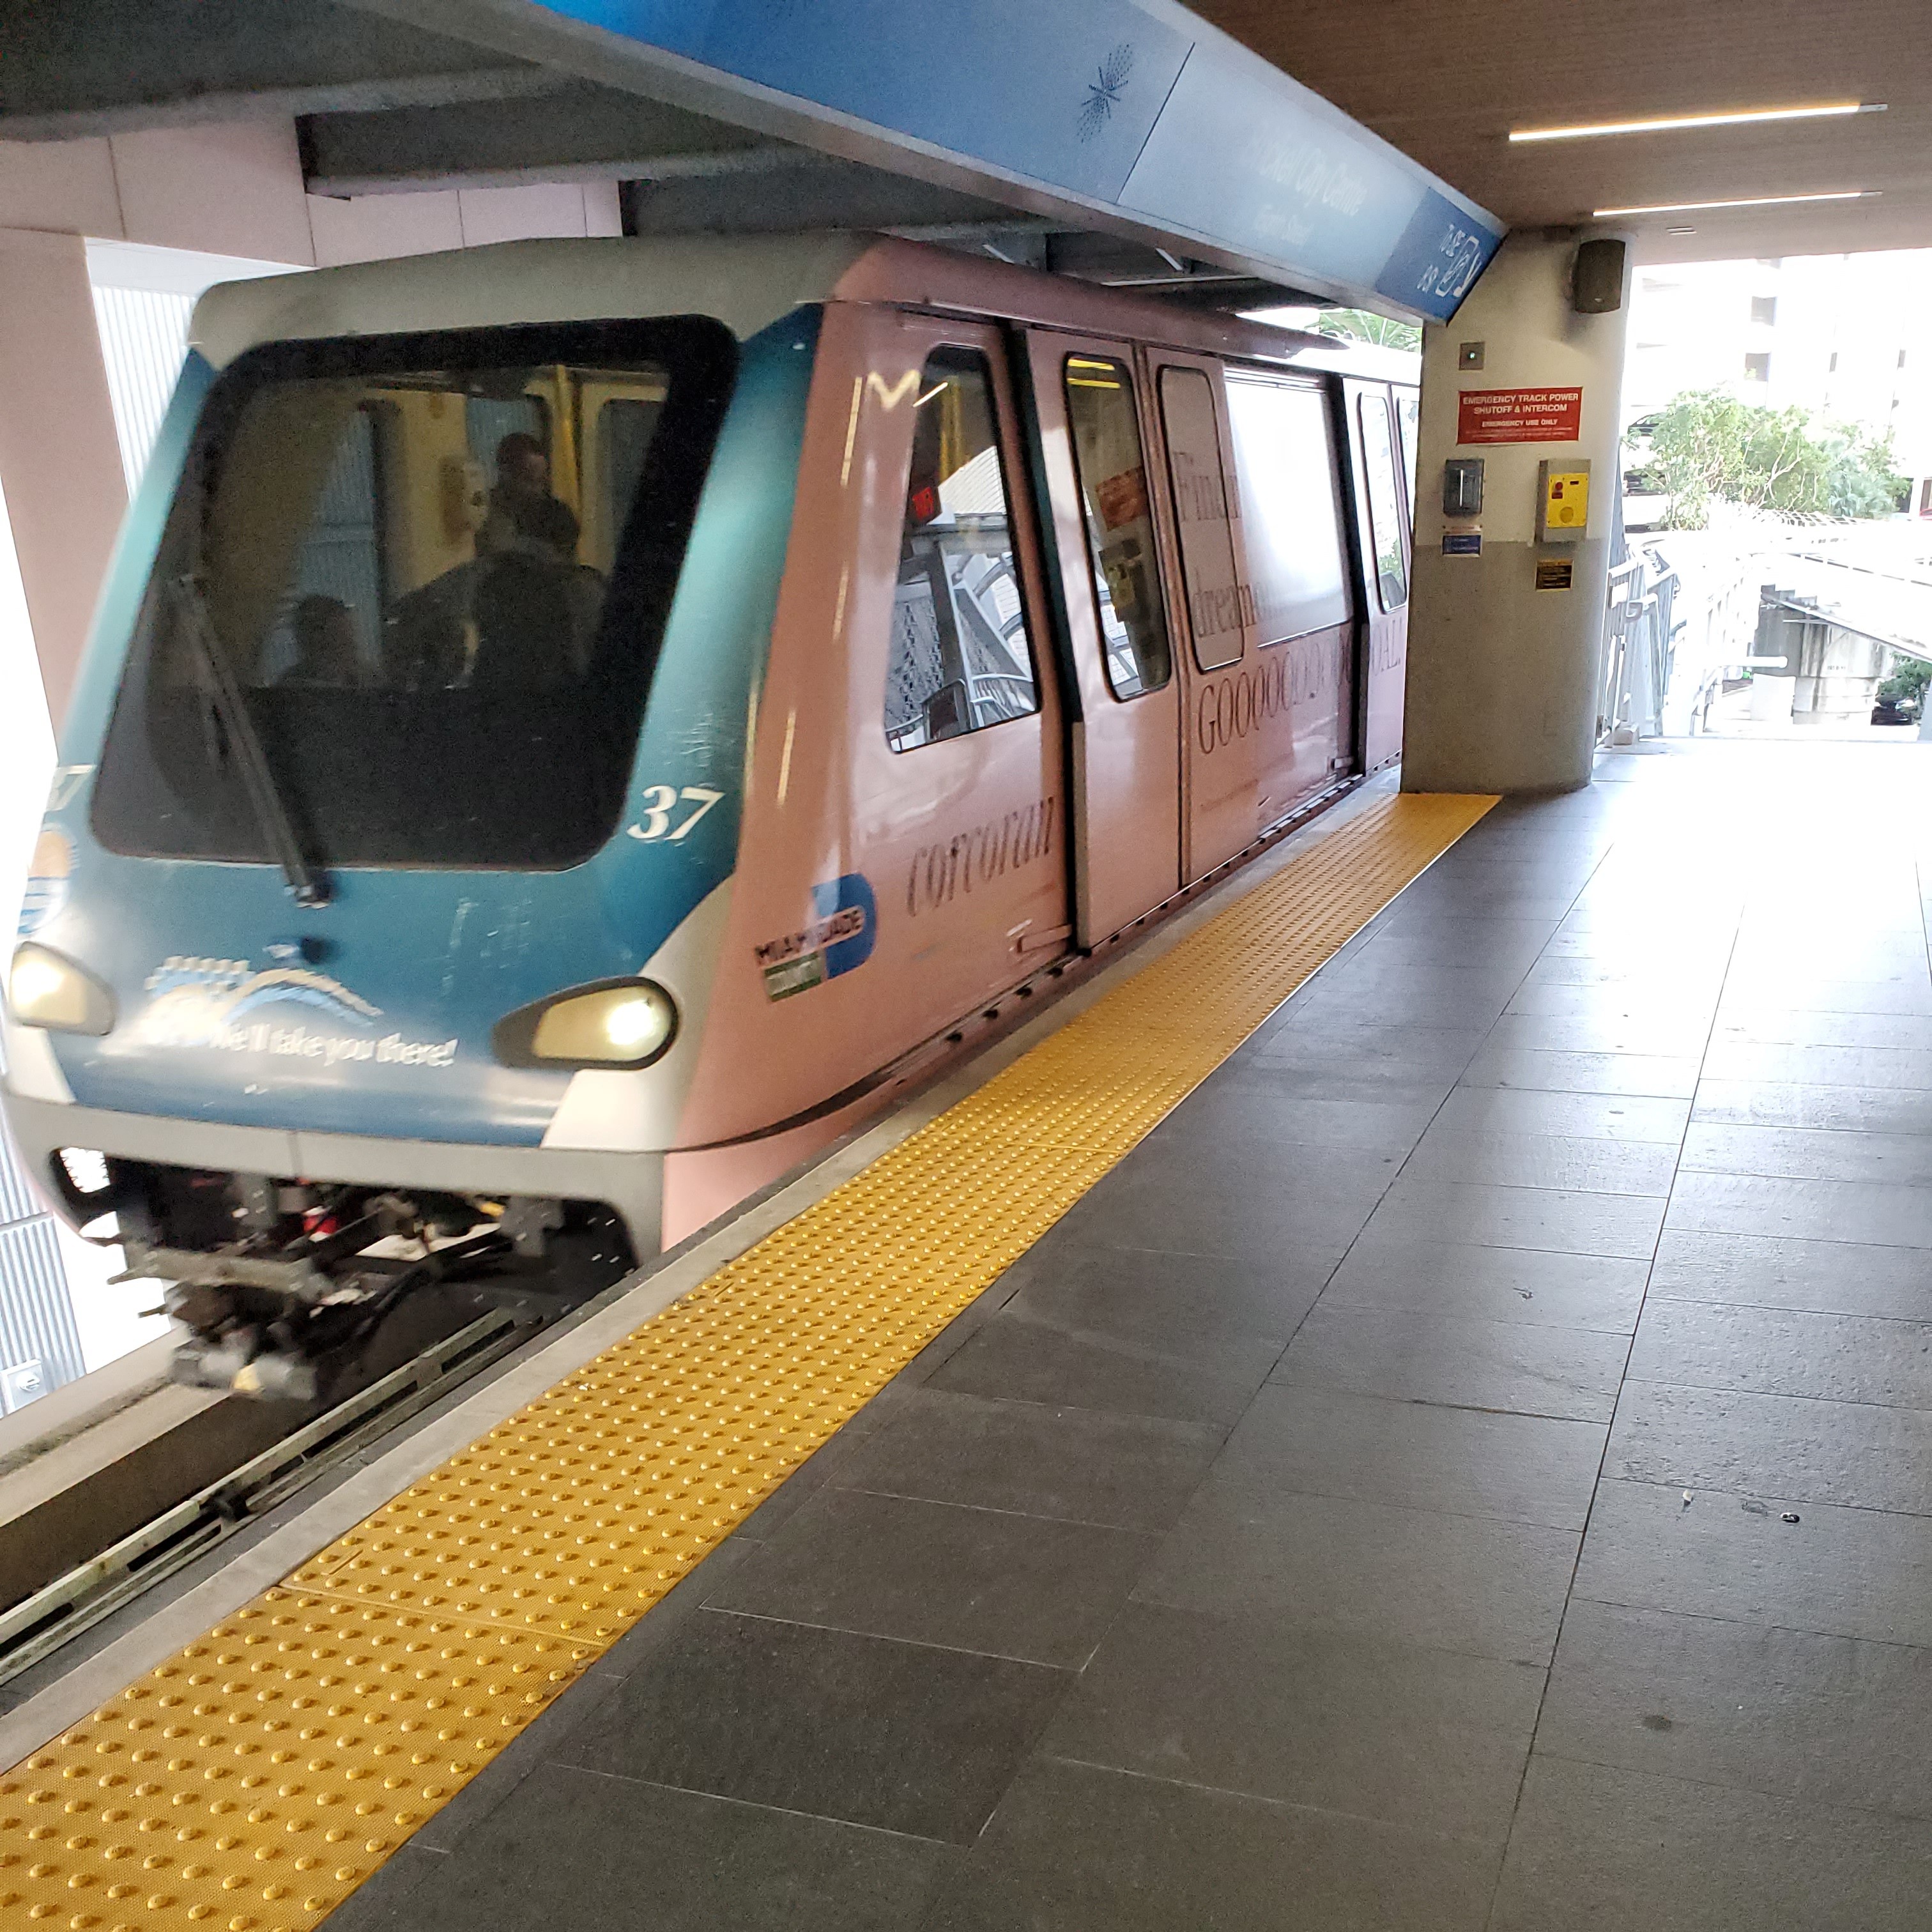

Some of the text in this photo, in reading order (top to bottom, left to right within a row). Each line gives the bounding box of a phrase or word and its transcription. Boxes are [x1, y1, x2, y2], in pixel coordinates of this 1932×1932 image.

[1292, 146, 1330, 209] City
[1321, 161, 1368, 218] Centre
[1462, 393, 1579, 405] EMERGENCY TRACK POWER
[1473, 403, 1567, 415] SHUTOFF & INTERCOM
[627, 785, 726, 840] 37
[268, 1026, 325, 1057] take
[323, 1036, 376, 1066] you
[376, 1032, 459, 1068] there!
